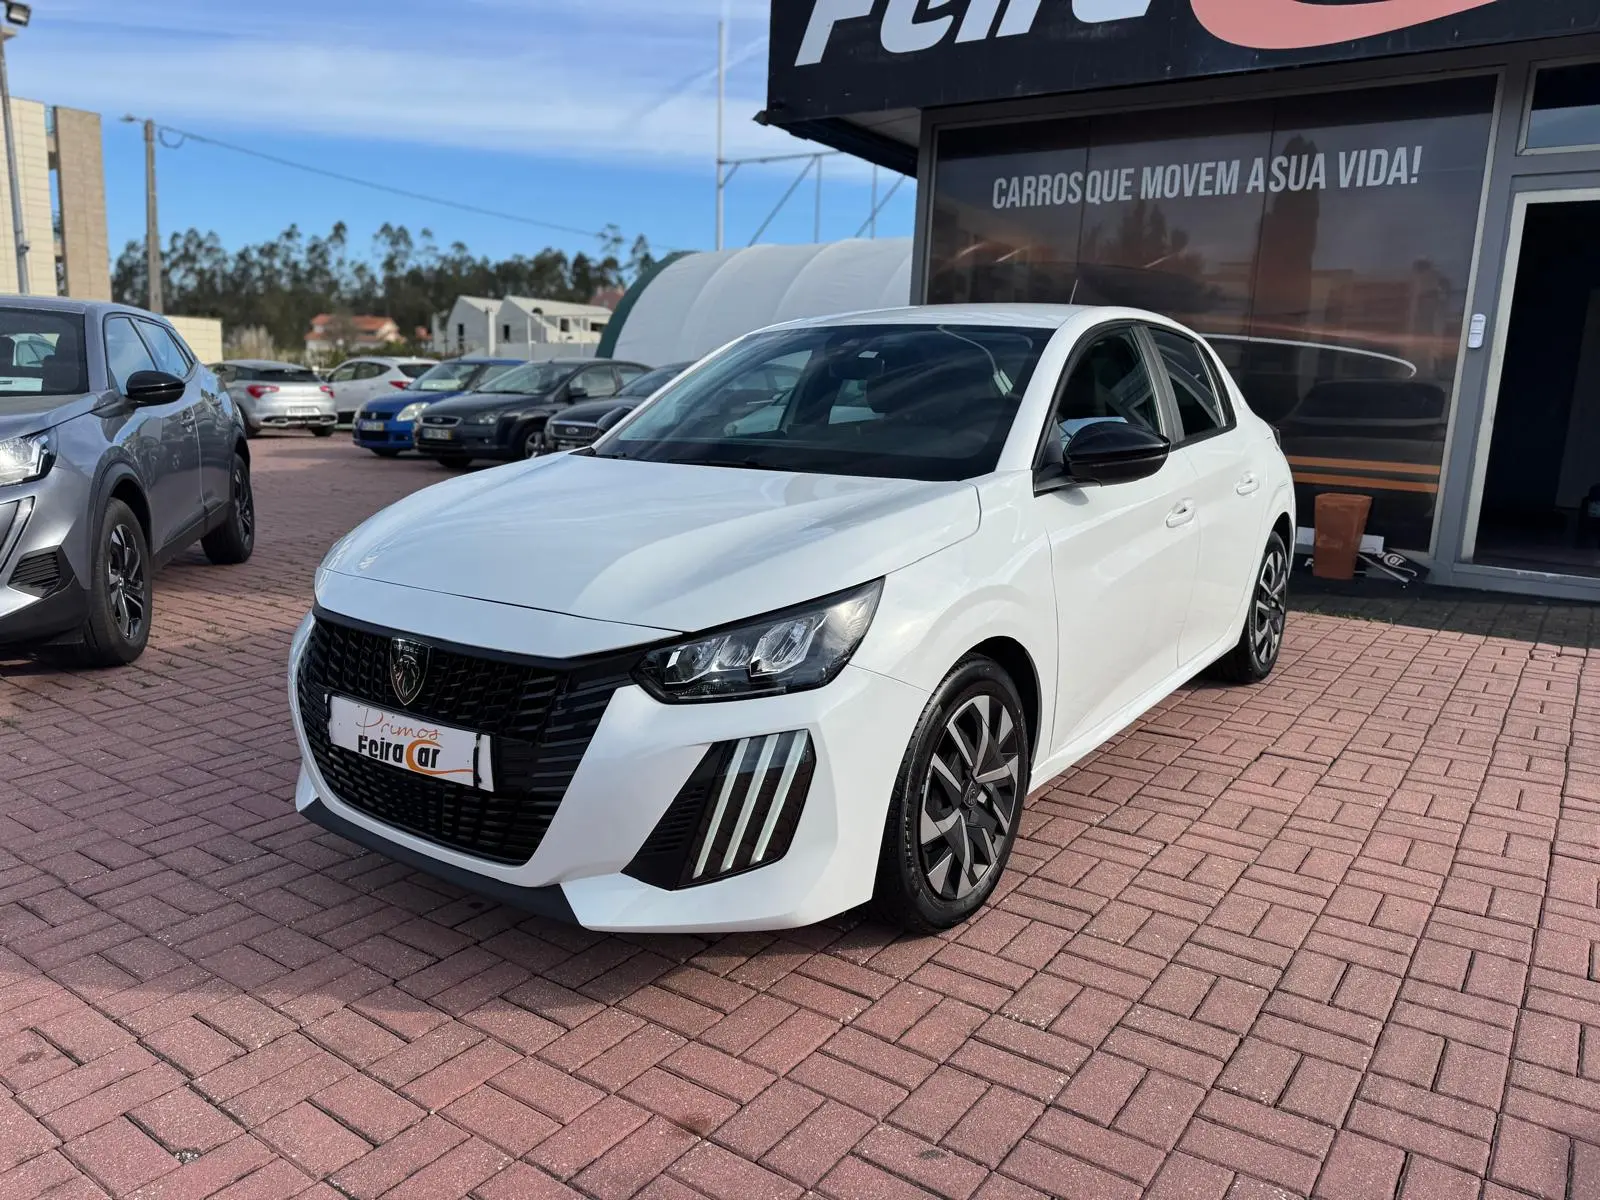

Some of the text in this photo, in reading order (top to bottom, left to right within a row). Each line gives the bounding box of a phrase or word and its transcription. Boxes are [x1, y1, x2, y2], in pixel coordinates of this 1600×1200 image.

[992, 171, 1084, 209] CARROS
[1085, 168, 1135, 205] QUE
[1140, 159, 1240, 200] MOVEM
[1338, 145, 1423, 189] VIDA!
[355, 707, 444, 740] Primos
